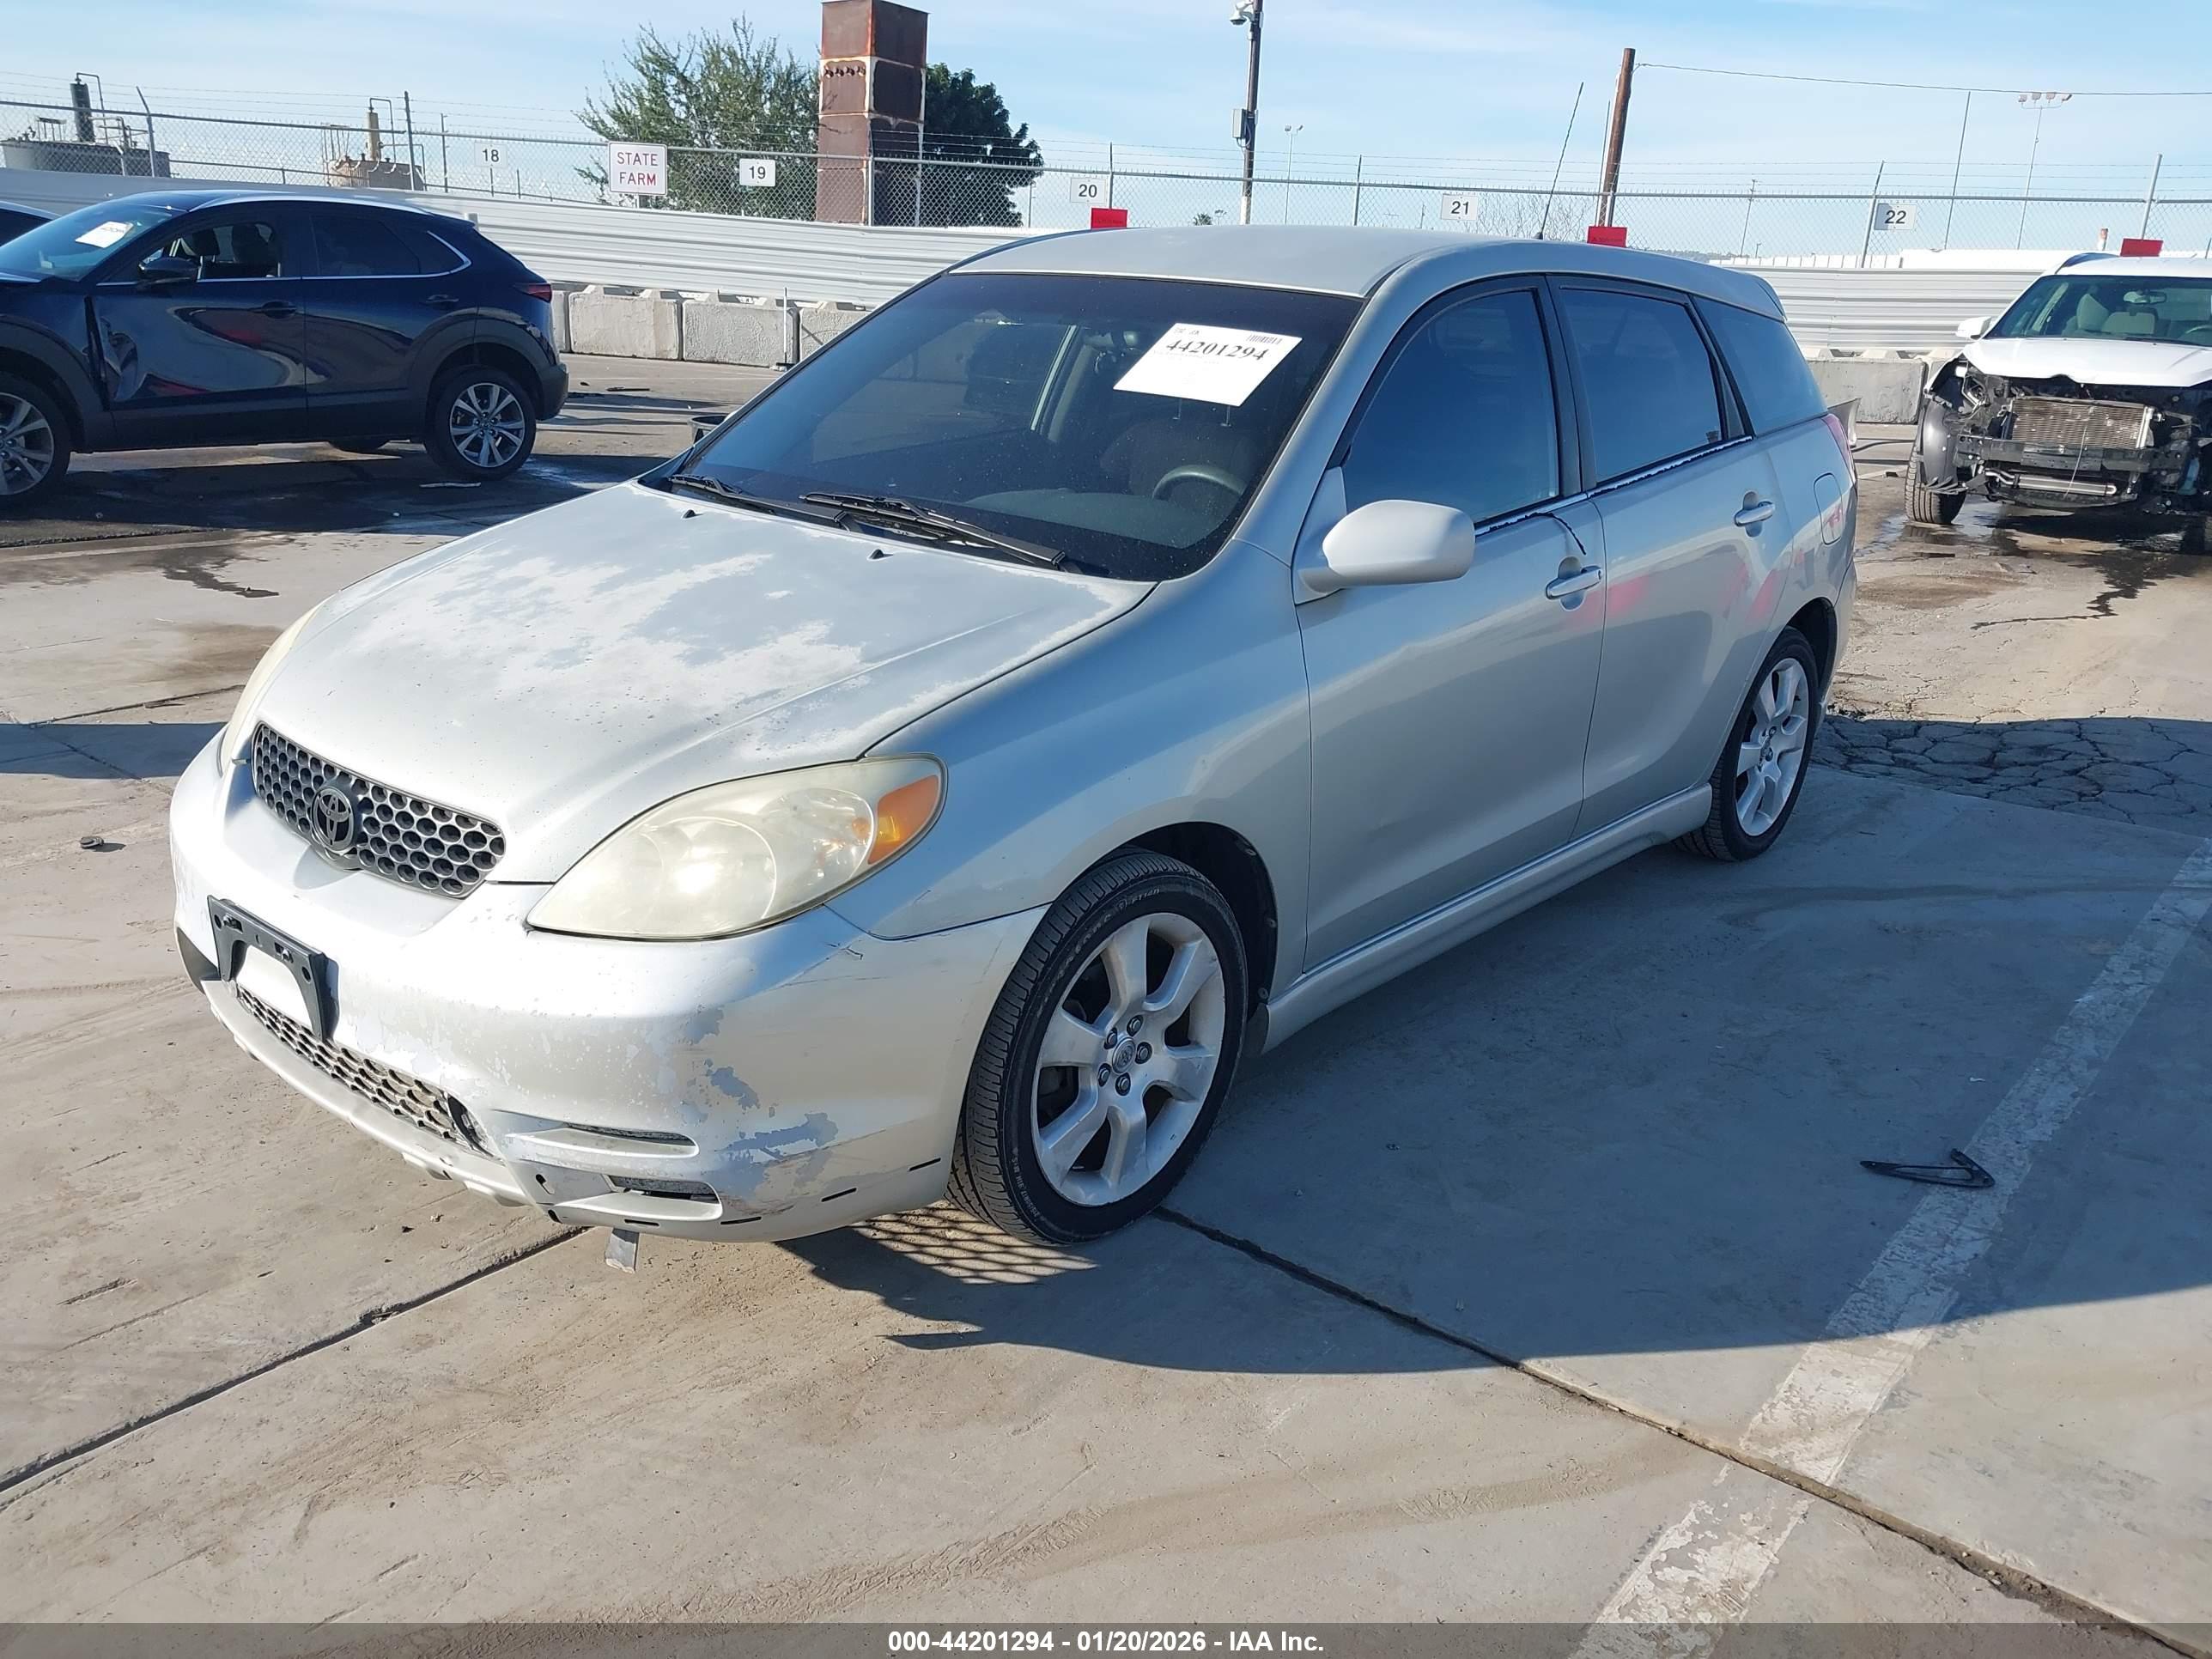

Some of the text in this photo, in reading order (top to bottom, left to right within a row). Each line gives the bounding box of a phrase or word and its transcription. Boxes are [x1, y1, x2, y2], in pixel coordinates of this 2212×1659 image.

[482, 148, 500, 163] 18
[617, 152, 658, 167] STATE
[619, 172, 656, 186] FARM
[749, 166, 766, 179] 19
[1078, 184, 1097, 198] 20
[1450, 200, 1469, 216] 21
[1884, 210, 1906, 224] 22
[1166, 339, 1269, 361] 44201294
